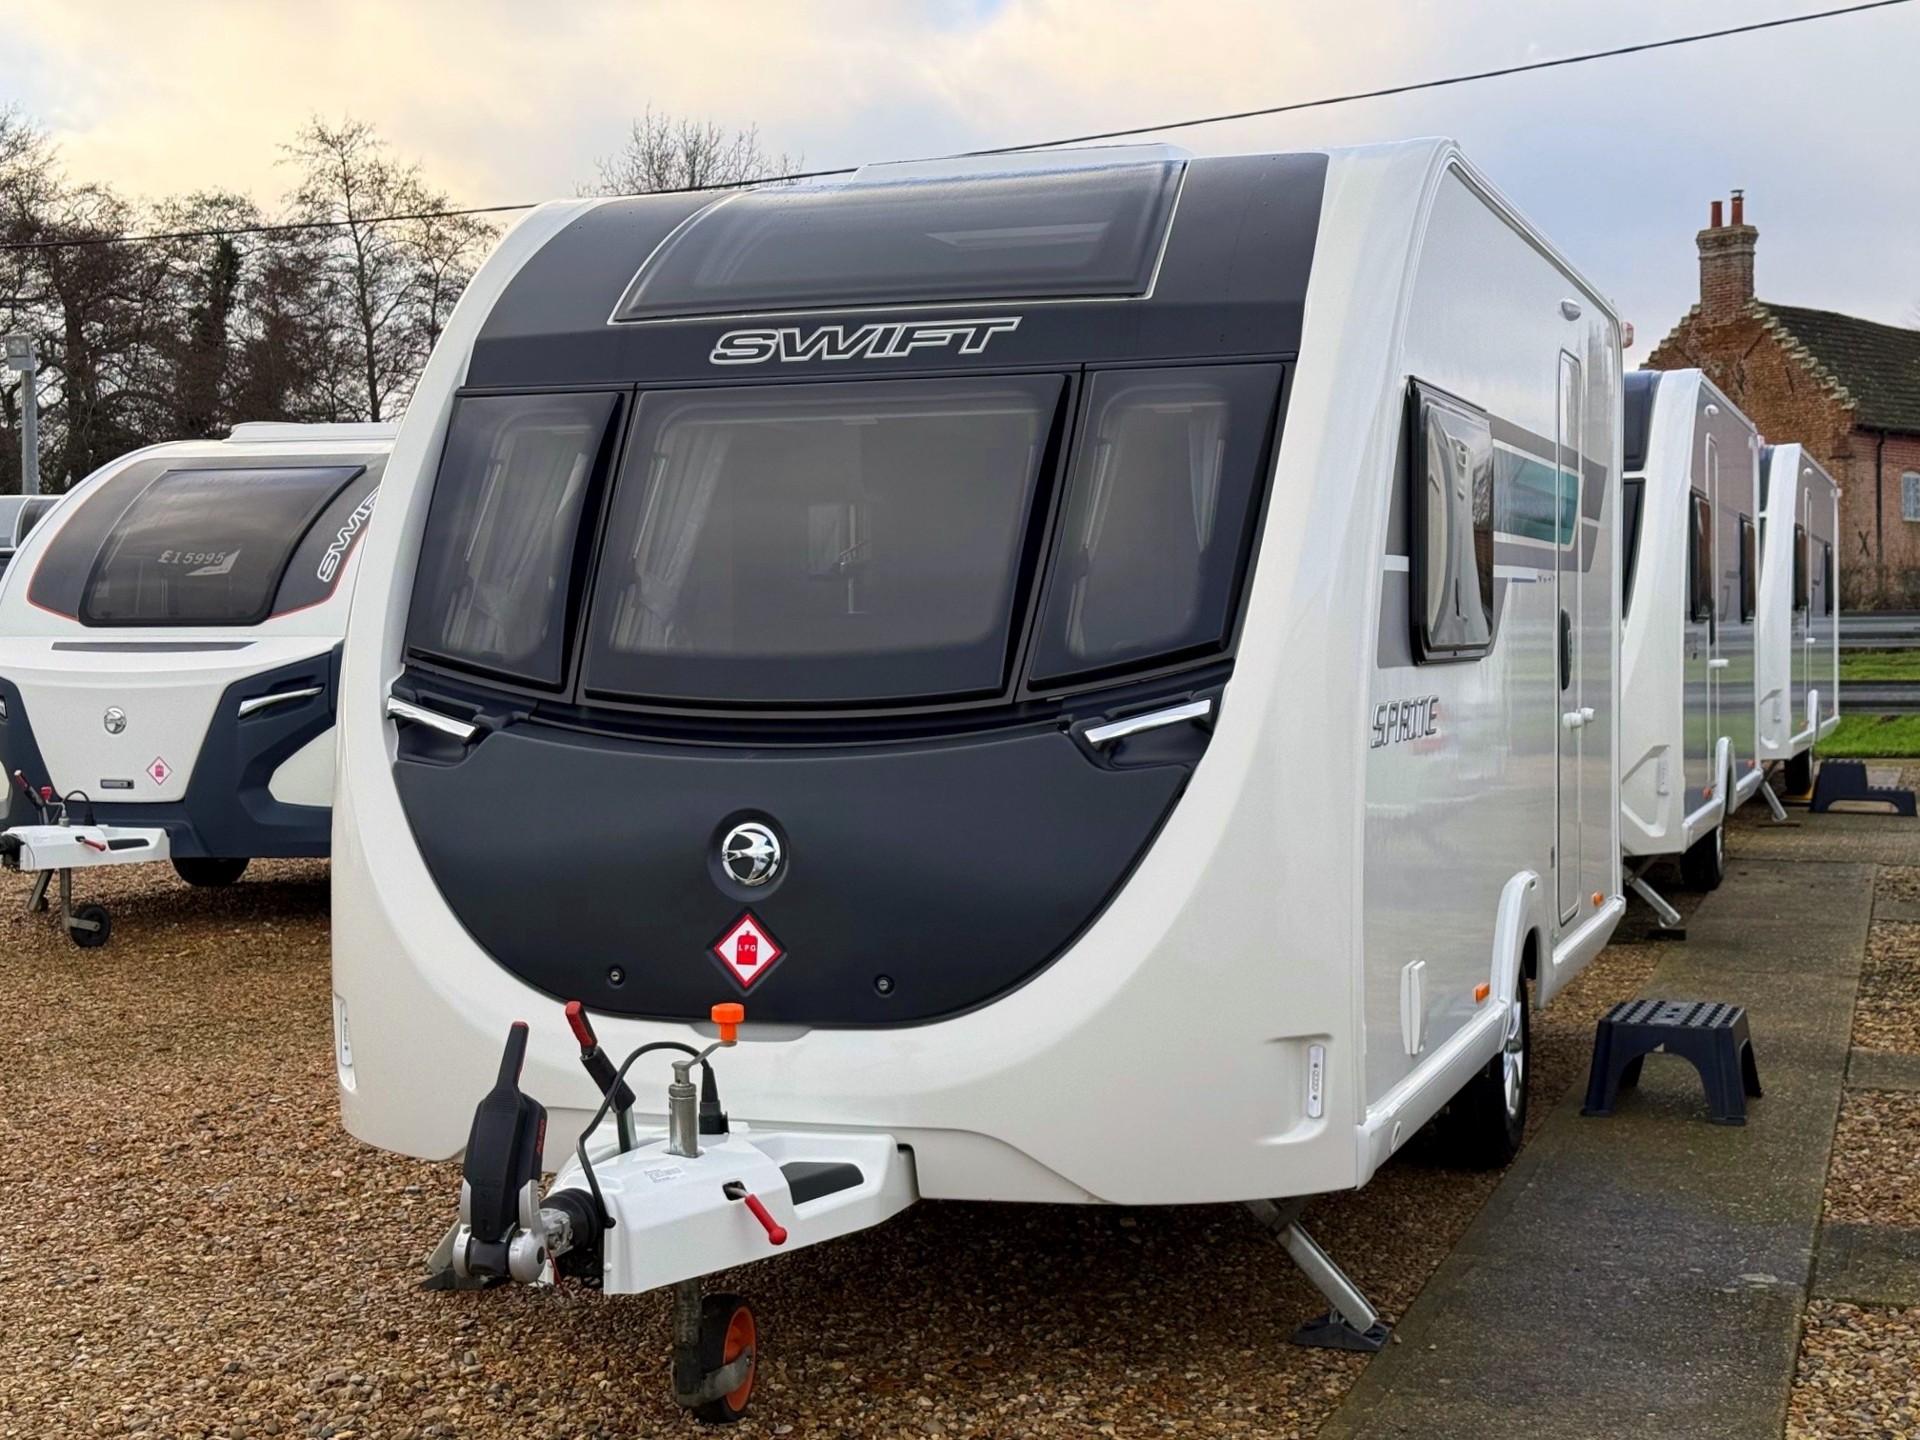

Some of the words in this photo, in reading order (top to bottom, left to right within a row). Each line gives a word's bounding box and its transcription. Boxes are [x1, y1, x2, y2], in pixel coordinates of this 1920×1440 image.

[709, 316, 1023, 365] SWIFT
[158, 550, 226, 565] £15995
[317, 484, 380, 583] SWIF
[1370, 694, 1439, 749] SPRITE
[738, 944, 757, 952] LPG
